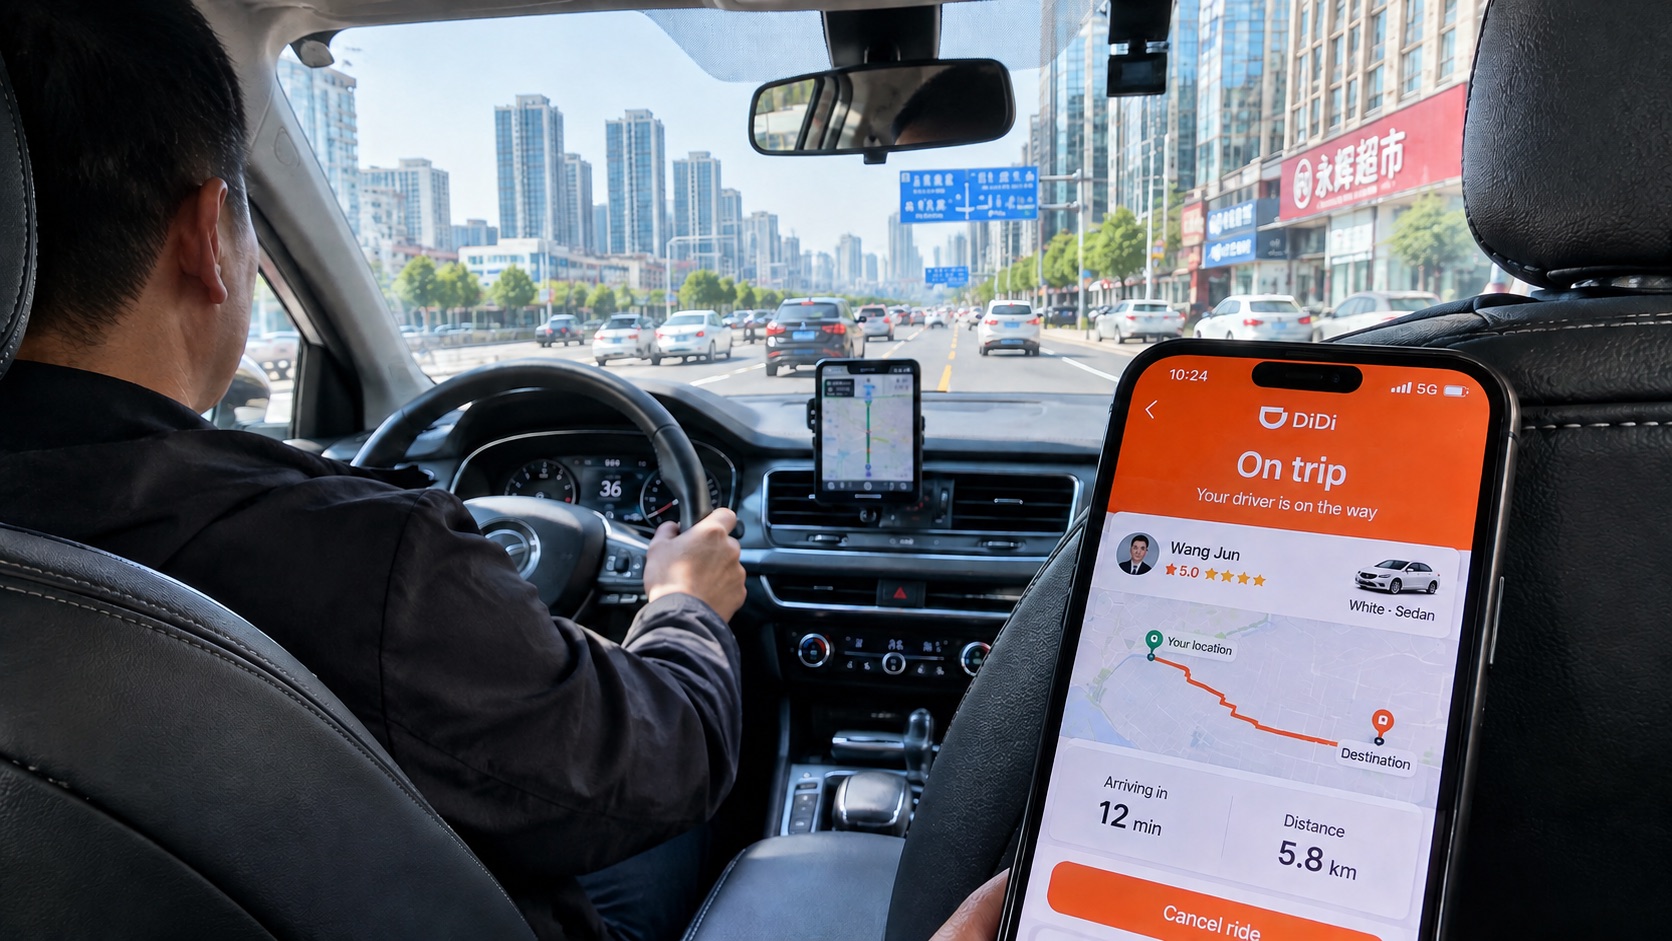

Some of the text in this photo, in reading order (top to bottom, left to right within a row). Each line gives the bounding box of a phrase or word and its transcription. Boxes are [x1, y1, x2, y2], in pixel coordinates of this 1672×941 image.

[1315, 127, 1406, 198] 永辉超市
[1170, 369, 1207, 381] 10:24
[1416, 384, 1438, 395] 5G
[1293, 413, 1336, 430] DiDi
[1238, 451, 1346, 491] On trip
[600, 481, 621, 497] 36
[1198, 488, 1377, 521] Your driver is on the way
[1172, 542, 1239, 561] Wang Jun
[1180, 566, 1199, 578] 5.0
[1350, 600, 1384, 614] White
[1396, 606, 1434, 621] Sedan
[1168, 637, 1232, 655] Your location
[1341, 748, 1410, 770] Destination
[1104, 776, 1167, 799] Arriving in
[1100, 801, 1161, 836] 12 min
[1284, 814, 1344, 837] Distance
[1279, 841, 1356, 880] 5.8 km
[1164, 905, 1260, 941] Cancel ride
